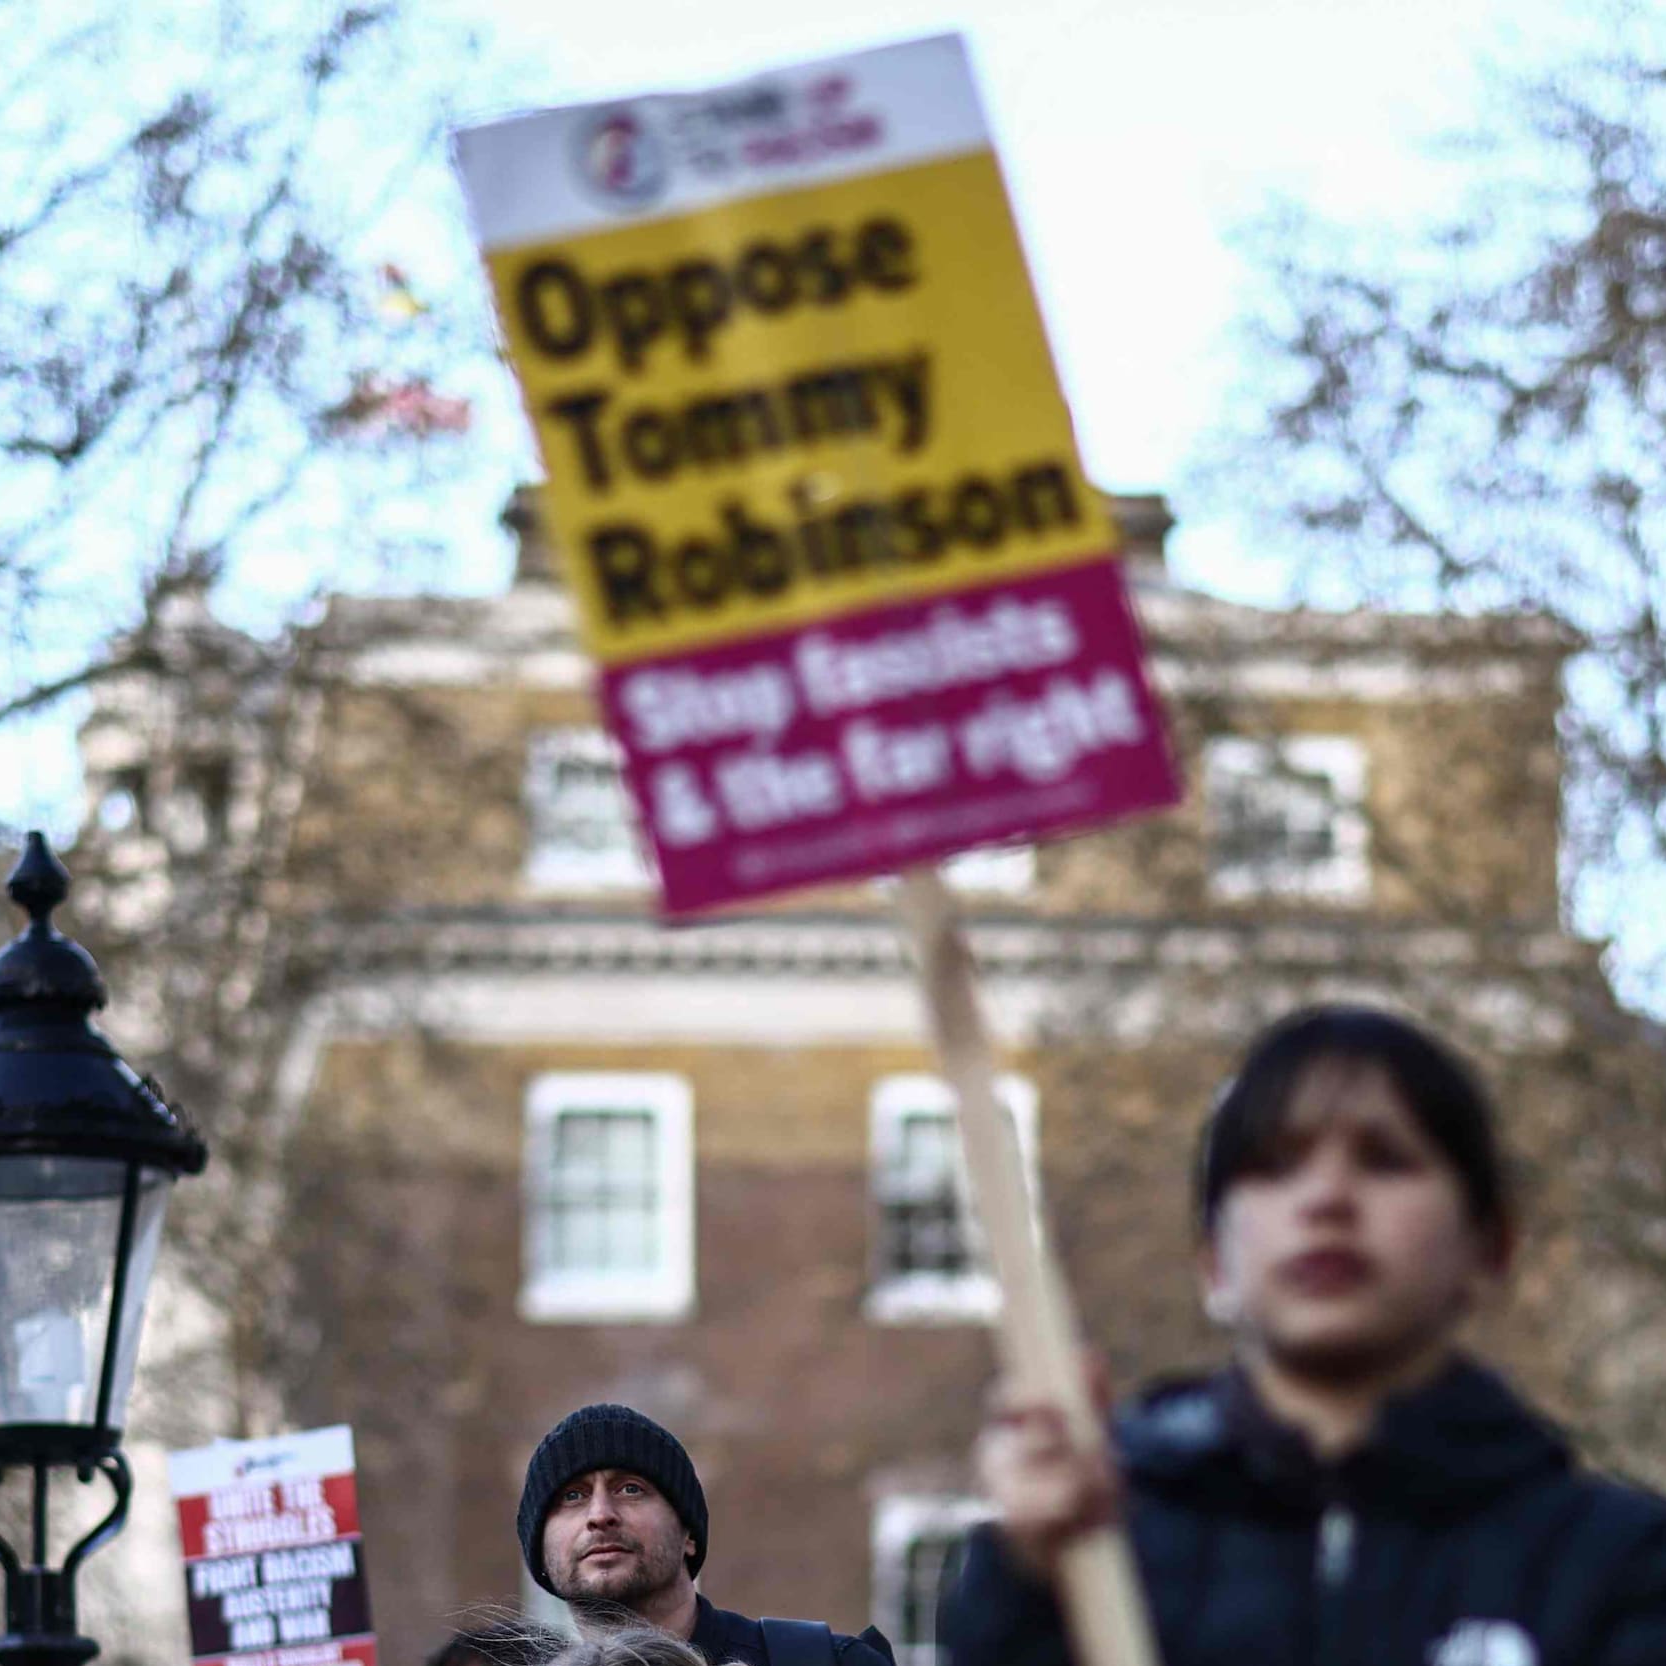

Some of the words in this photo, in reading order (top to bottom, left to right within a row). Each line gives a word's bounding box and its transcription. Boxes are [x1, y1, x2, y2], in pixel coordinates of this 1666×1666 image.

[517, 215, 921, 375] Oppose
[547, 349, 931, 496] Tommy
[587, 457, 1083, 632] Robinson
[619, 661, 795, 755] Stop
[795, 600, 1080, 719] fascists
[651, 762, 718, 847] &
[718, 740, 844, 830] the
[842, 712, 951, 802] far
[959, 668, 1144, 784] right
[193, 1554, 258, 1599] FIGHT
[261, 1542, 355, 1586] RACISM
[222, 1580, 333, 1622] AUSTERITY
